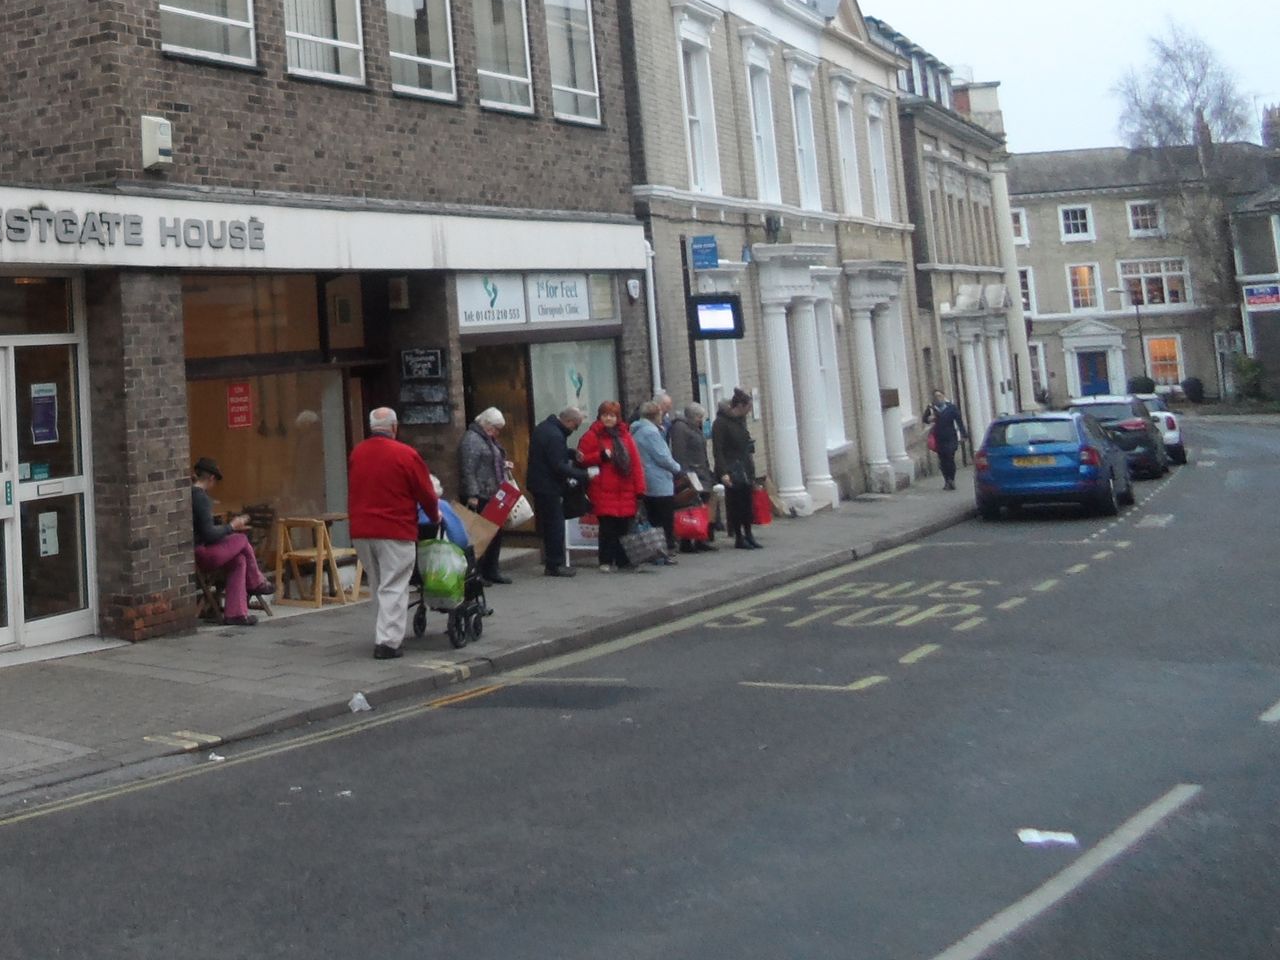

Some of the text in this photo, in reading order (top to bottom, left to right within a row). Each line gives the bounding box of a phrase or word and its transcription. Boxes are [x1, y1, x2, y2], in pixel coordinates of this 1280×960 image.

[158, 216, 266, 250] HOUSE
[545, 280, 559, 298] for
[475, 309, 496, 321] 01473
[497, 309, 508, 320] 210
[538, 303, 580, 318] Chiropody Clinic
[808, 581, 1000, 600] BUS
[704, 603, 983, 628] STOP
